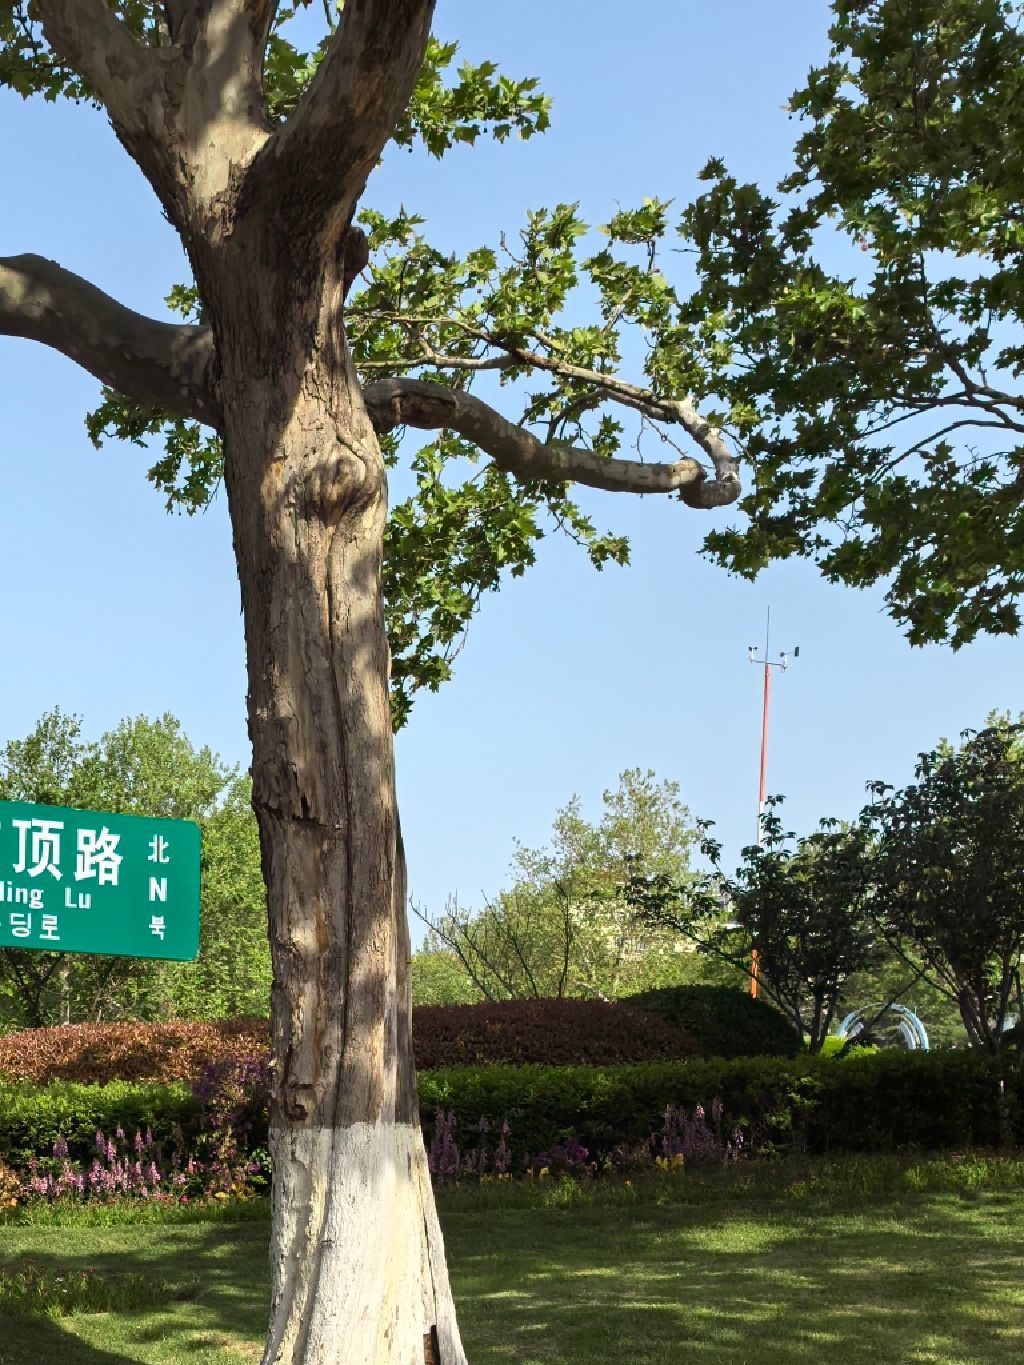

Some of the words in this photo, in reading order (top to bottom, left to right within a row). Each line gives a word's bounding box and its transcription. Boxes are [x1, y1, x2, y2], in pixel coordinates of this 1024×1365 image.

[148, 834, 170, 863] 北
[64, 886, 92, 910] Lu
[148, 876, 168, 902] N
[148, 915, 167, 941] 북
